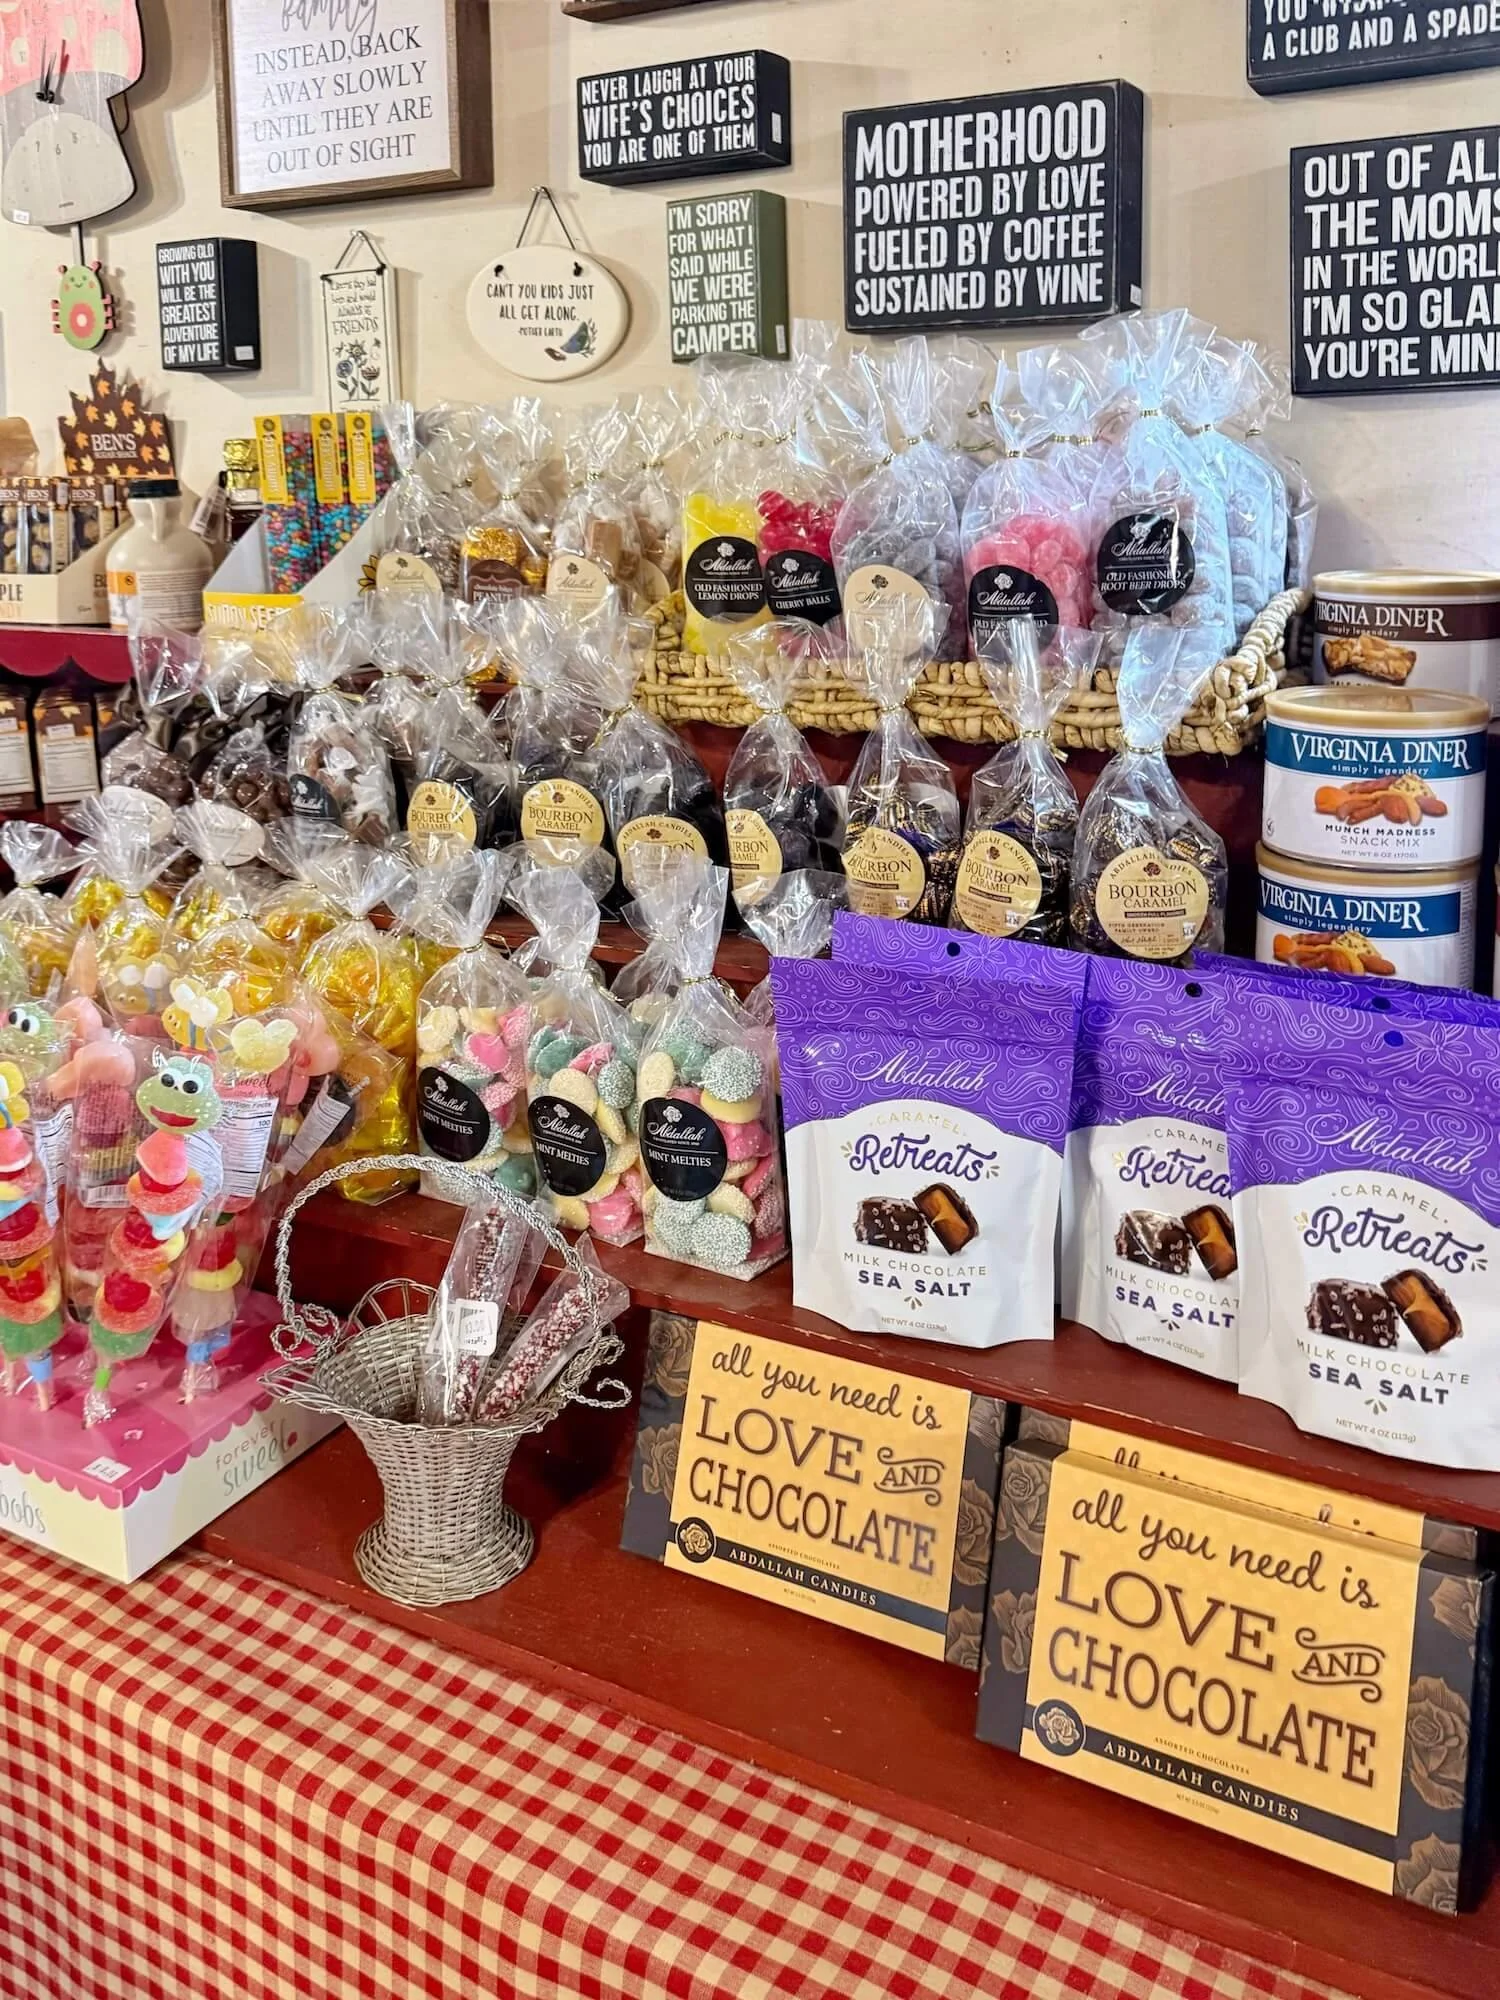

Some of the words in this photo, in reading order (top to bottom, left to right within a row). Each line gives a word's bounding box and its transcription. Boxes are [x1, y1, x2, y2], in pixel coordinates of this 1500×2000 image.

[256, 39, 352, 74] INSTEAD,
[358, 26, 422, 57] BACK
[1262, 32, 1276, 61] A
[1285, 23, 1340, 58] CLUB
[1348, 16, 1394, 50] AND
[1403, 13, 1418, 43] A
[263, 77, 327, 108] AWAY
[334, 60, 426, 96] SLOWLY
[581, 74, 628, 106] NEVER
[634, 67, 682, 98] LAUGH
[689, 63, 708, 89] AT
[714, 55, 755, 81] YOUR
[254, 114, 316, 142] UNTIL
[322, 103, 379, 132] THEY
[387, 95, 432, 123] ARE
[583, 99, 653, 141] WIFE'S
[662, 84, 755, 130] CHOICES
[268, 148, 310, 174] OUT
[316, 143, 344, 167] OF
[350, 133, 416, 163] SIGHT
[584, 142, 612, 169] YOU
[618, 137, 647, 165] ARE
[653, 132, 682, 160] ONE
[688, 129, 706, 155] OF
[713, 122, 755, 152] THEM
[855, 98, 1107, 181] MOTHERHOOD
[1304, 150, 1375, 199] OUT
[1387, 144, 1433, 190] OF
[855, 175, 982, 227] POWERED
[993, 170, 1028, 216] BY
[1038, 162, 1106, 212] LOVE
[669, 206, 692, 231] I'M
[696, 197, 751, 227] SORRY
[1304, 199, 1380, 250] THE
[159, 245, 196, 263] GROWING
[197, 243, 214, 259] OLD
[669, 233, 697, 255] FOR
[701, 226, 745, 251] WHAT
[748, 225, 753, 245] I
[855, 225, 948, 274] FUELED
[958, 221, 994, 266] BY
[1003, 211, 1105, 263] COFFEE
[160, 263, 189, 285] WITH
[192, 261, 215, 282] YOU
[670, 255, 704, 278] SAID
[707, 249, 754, 274] WHILE
[1304, 255, 1332, 291] IN
[1341, 250, 1398, 288] THE
[160, 287, 182, 304] WILL
[184, 286, 196, 301] BE
[198, 283, 216, 300] THE
[487, 284, 514, 298] CAN'T
[518, 284, 537, 299] YOU
[541, 284, 564, 299] KIDS
[568, 285, 594, 300] JUST
[672, 278, 699, 305] WE
[703, 272, 755, 301] WERE
[855, 270, 986, 317] SUSTAINED
[995, 267, 1028, 308] BY
[1036, 262, 1103, 306] WINE
[161, 301, 216, 324] GREATEST
[500, 305, 516, 320] ALL
[521, 305, 540, 320] GET
[672, 302, 727, 326] PARKING
[730, 299, 756, 321] THE
[1303, 294, 1351, 337] I'M
[1362, 291, 1407, 333] SO
[164, 323, 218, 343] ADVENTURE
[673, 321, 757, 356] CAMPER
[165, 345, 177, 364] OF
[179, 344, 195, 362] MY
[197, 342, 219, 361] LIFE
[1304, 337, 1420, 380] YOU'RE
[91, 433, 136, 451] BEN'S
[695, 583, 711, 591] OLD
[713, 583, 762, 592] FASHIONED
[1101, 581, 1128, 591] ROOT
[1129, 581, 1151, 590] BEER
[1106, 572, 1126, 581] OLD
[698, 592, 729, 600] LEMON
[730, 592, 760, 600] DROPS
[776, 600, 804, 609] CHERRY
[807, 595, 831, 606] BALLS
[1315, 600, 1370, 626] VIRGINIA
[1376, 607, 1449, 637] DINER
[1291, 732, 1396, 763] VIRGINIA
[1403, 739, 1472, 770] DINER
[1332, 764, 1369, 775] simply
[1374, 766, 1429, 775] legendary
[529, 807, 593, 824] BOURBON
[536, 820, 580, 830] CARAMEL
[1325, 824, 1369, 835] MUNCH
[1376, 828, 1436, 836] MADNESS
[1341, 835, 1389, 847] SNACK
[1396, 838, 1420, 847] MIX
[849, 854, 912, 873] BOURBON
[851, 868, 899, 881] CARAMEL
[966, 858, 1029, 887] BOURBON
[970, 876, 1013, 894] CARAMEL
[1109, 879, 1198, 899] BOURBON
[1124, 897, 1187, 908] CARAMEL
[1261, 879, 1340, 920] VIRGINIA
[1344, 899, 1426, 932] DINER
[850, 1047, 997, 1092] Abdallah
[647, 1122, 706, 1141] Abdallah
[1306, 1112, 1487, 1176] Abdallah
[536, 1142, 556, 1155] MINT
[556, 1149, 589, 1165] MELTIES
[648, 1149, 669, 1162] MINT
[671, 1155, 711, 1167] MELTIES
[850, 1133, 998, 1182] Retreats
[1304, 1205, 1485, 1274] Retreats
[844, 1252, 880, 1266] MILK
[888, 1260, 987, 1277] CHOCOLATE
[858, 1270, 901, 1289] SEA
[915, 1280, 971, 1296] SALT
[1296, 1338, 1335, 1361] MILK
[1346, 1354, 1471, 1385] CHOCOLATE
[712, 1343, 754, 1378] all
[761, 1363, 821, 1399] you
[830, 1384, 902, 1419] need
[912, 1396, 942, 1431] is
[1309, 1363, 1362, 1390] SEA
[1378, 1380, 1449, 1405] SALT
[216, 1420, 275, 1471] forever
[696, 1395, 864, 1485] LOVE
[880, 1463, 941, 1488] AND
[1336, 1418, 1352, 1428] NET
[1353, 1423, 1368, 1433] WT
[1377, 1429, 1390, 1438] OZ
[689, 1456, 937, 1576] CHOCOLATE
[1072, 1489, 1127, 1534] all
[1138, 1514, 1216, 1561] you
[1229, 1545, 1326, 1593] need
[1340, 1565, 1379, 1610] is
[729, 1548, 804, 1582] ABDALLAH
[811, 1575, 876, 1606] CANDIES
[1055, 1550, 1276, 1672] LOVE
[1300, 1651, 1382, 1678] AND
[1049, 1626, 1376, 1788] CHOCOLATE
[1154, 1736, 1195, 1754] ASSORTED
[1196, 1748, 1251, 1775] CHOCOLATES
[1104, 1741, 1203, 1787] ABDALLAH
[1211, 1780, 1300, 1822] CANDIES
